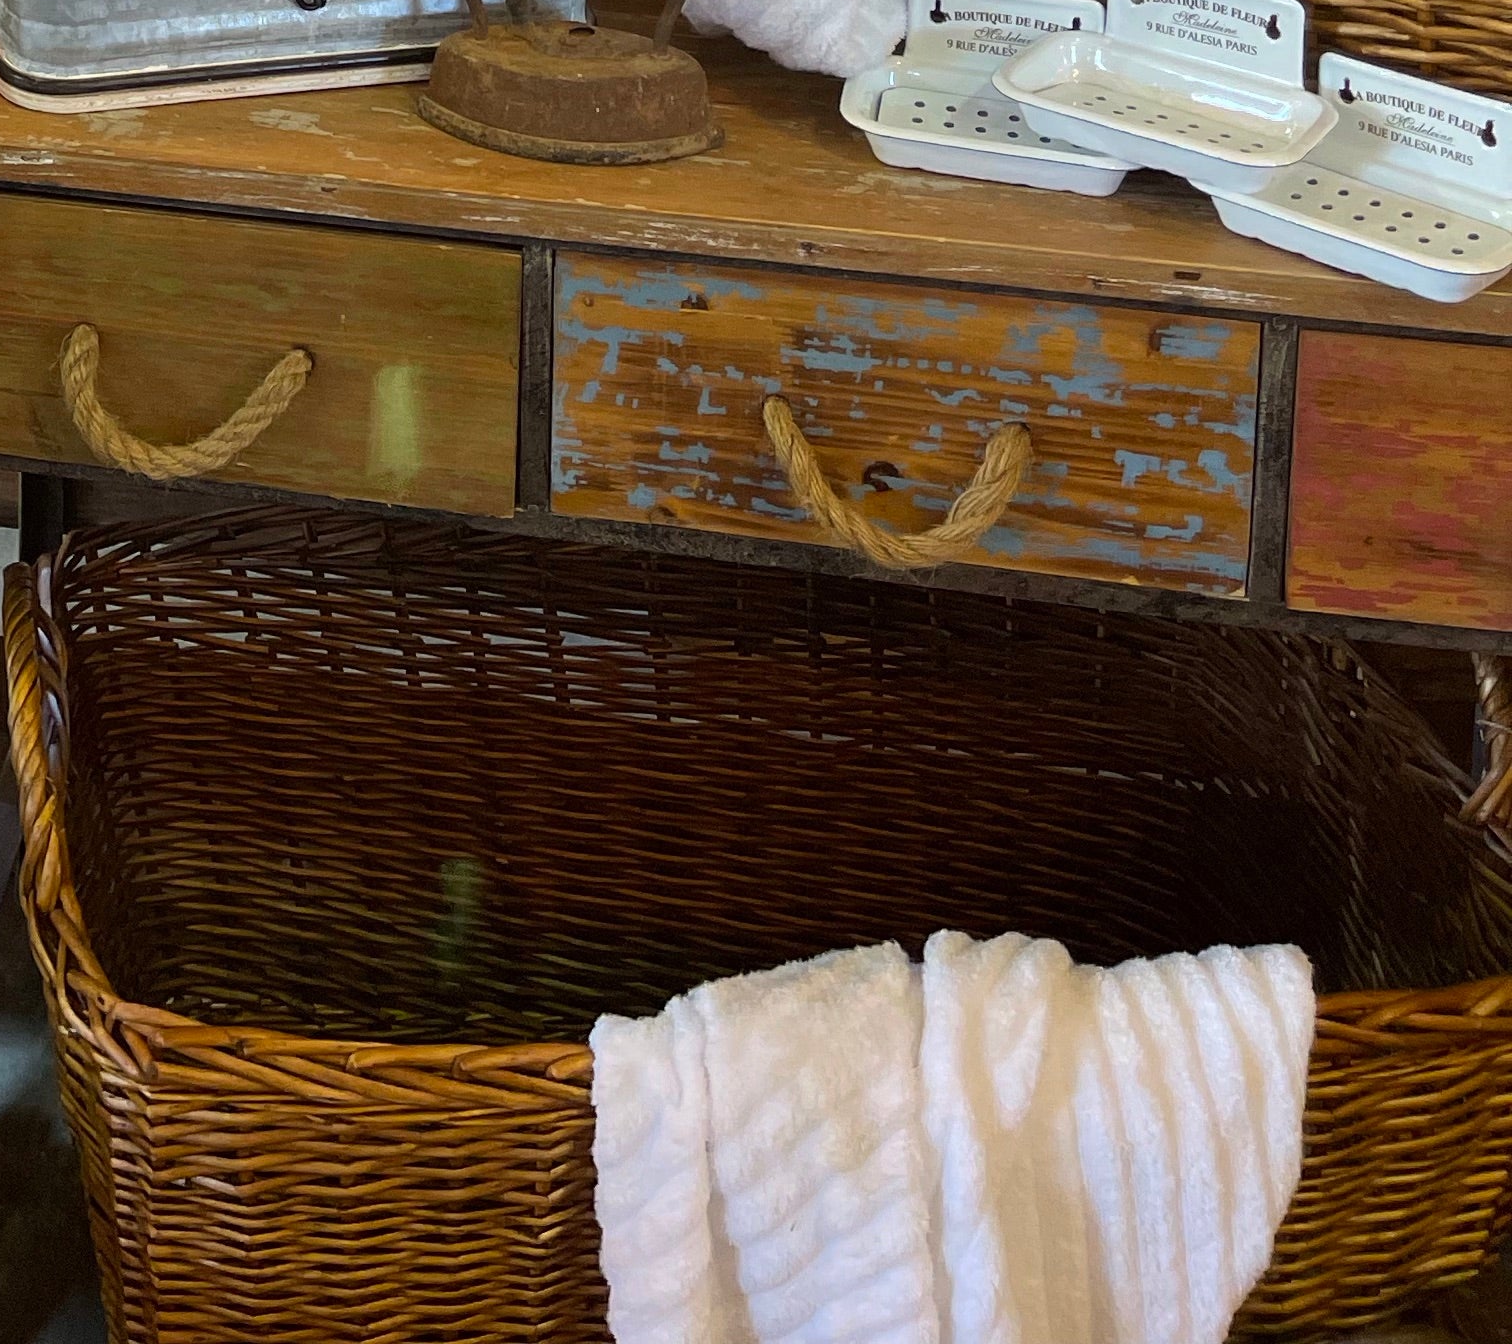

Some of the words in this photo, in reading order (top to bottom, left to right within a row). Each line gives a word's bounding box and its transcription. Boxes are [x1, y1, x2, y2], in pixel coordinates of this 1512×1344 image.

[954, 11, 1013, 26] BOUTIQUE
[1015, 15, 1032, 28] DE
[1211, 1, 1229, 16] DE
[946, 38, 954, 49] 9
[956, 40, 977, 52] RUE
[1146, 21, 1154, 31] 9
[1155, 22, 1176, 37] RUE
[1177, 28, 1224, 50] D'ALESIA
[1224, 38, 1259, 57] PARIS
[1365, 90, 1427, 116] BOUTIQUE
[1427, 106, 1446, 122] DE
[1357, 120, 1366, 132] 9
[1367, 123, 1389, 140] RUE
[1389, 131, 1438, 156] D'ALESIA
[1439, 146, 1475, 167] PARIS
